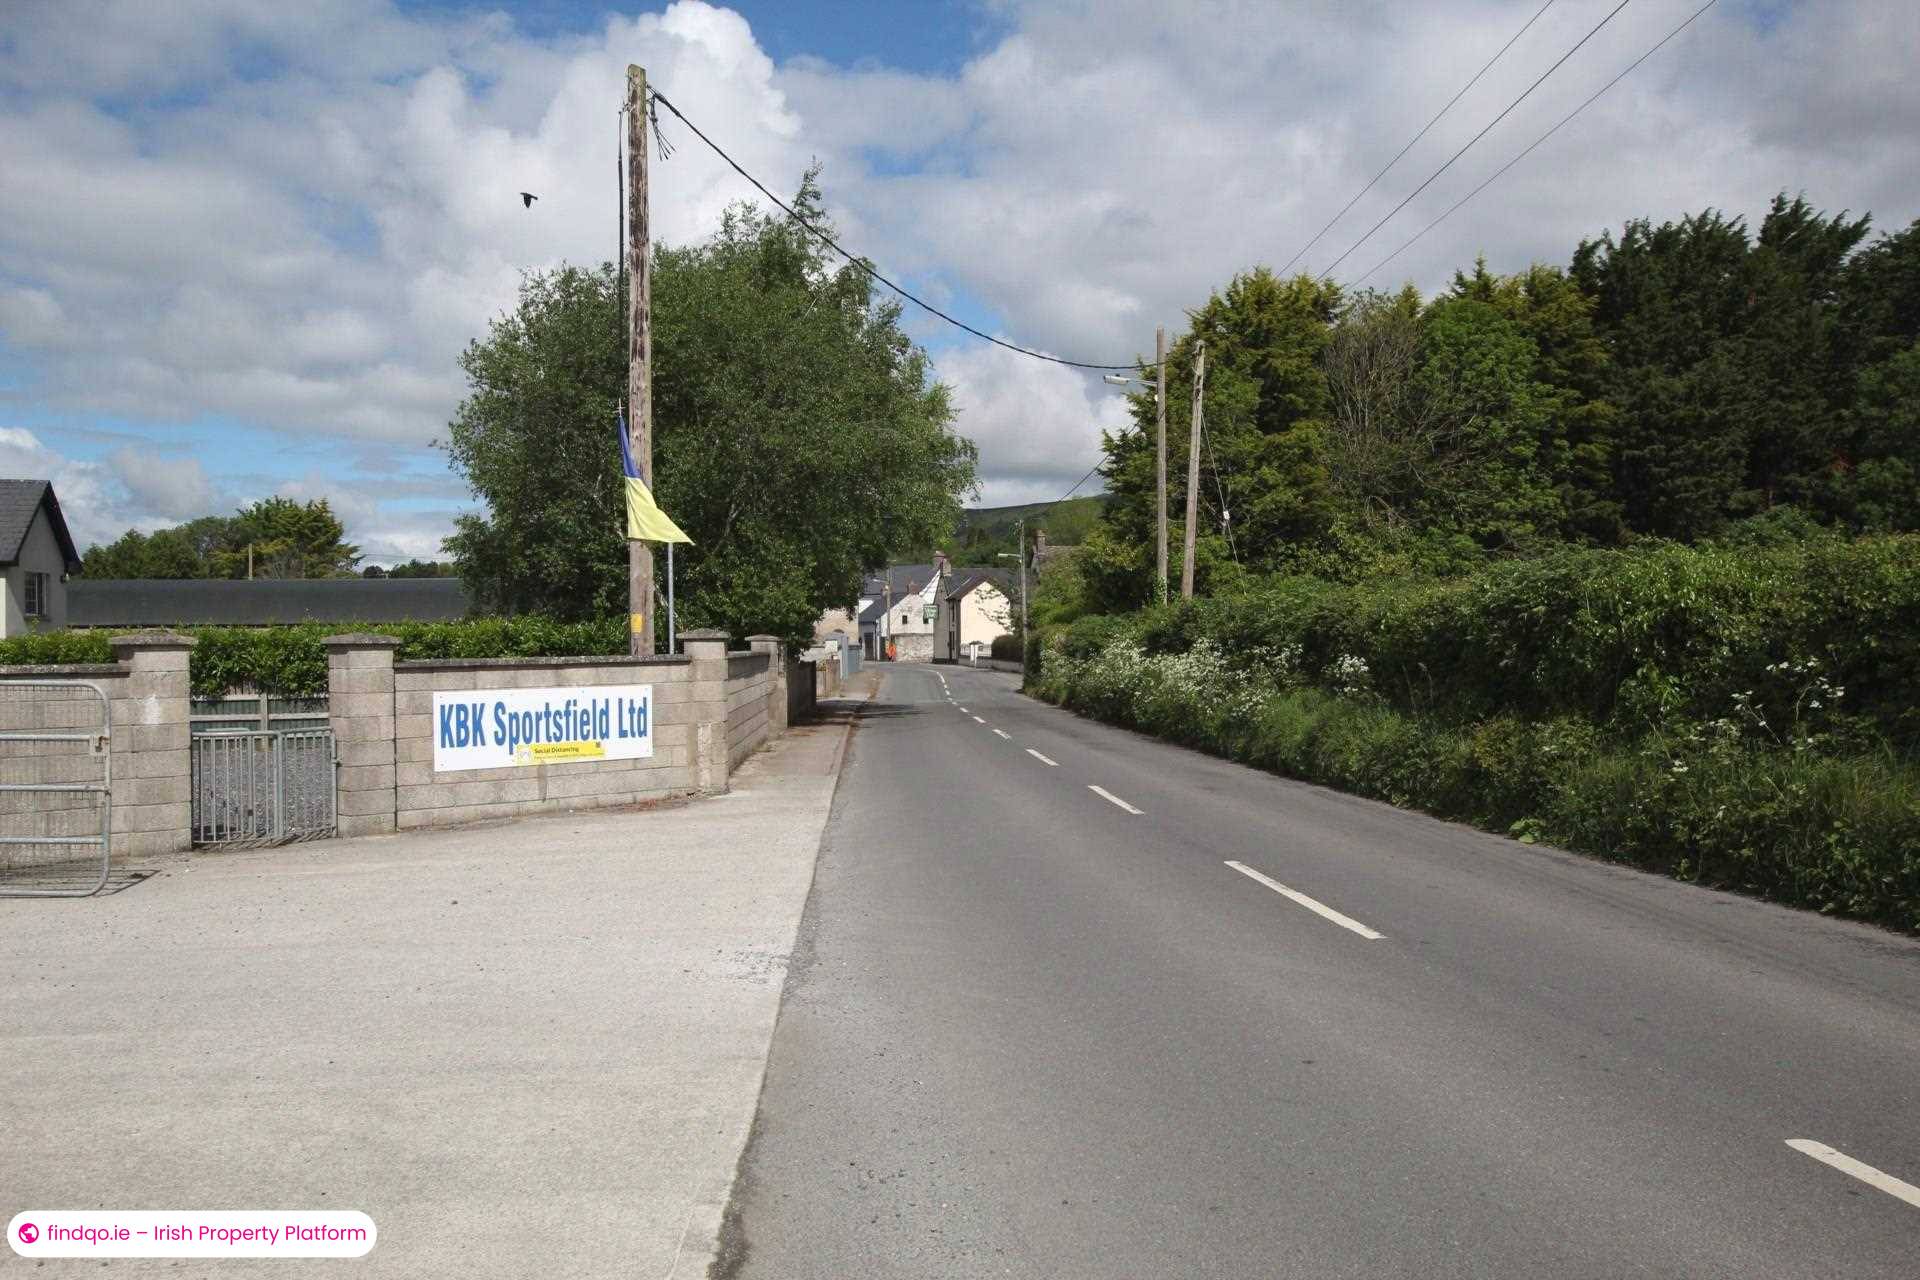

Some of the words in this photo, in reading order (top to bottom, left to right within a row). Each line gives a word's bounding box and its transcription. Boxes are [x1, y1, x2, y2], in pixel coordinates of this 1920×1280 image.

[440, 703, 485, 748] KBK
[494, 698, 609, 755] Sportsfield
[618, 697, 647, 738] Ltd
